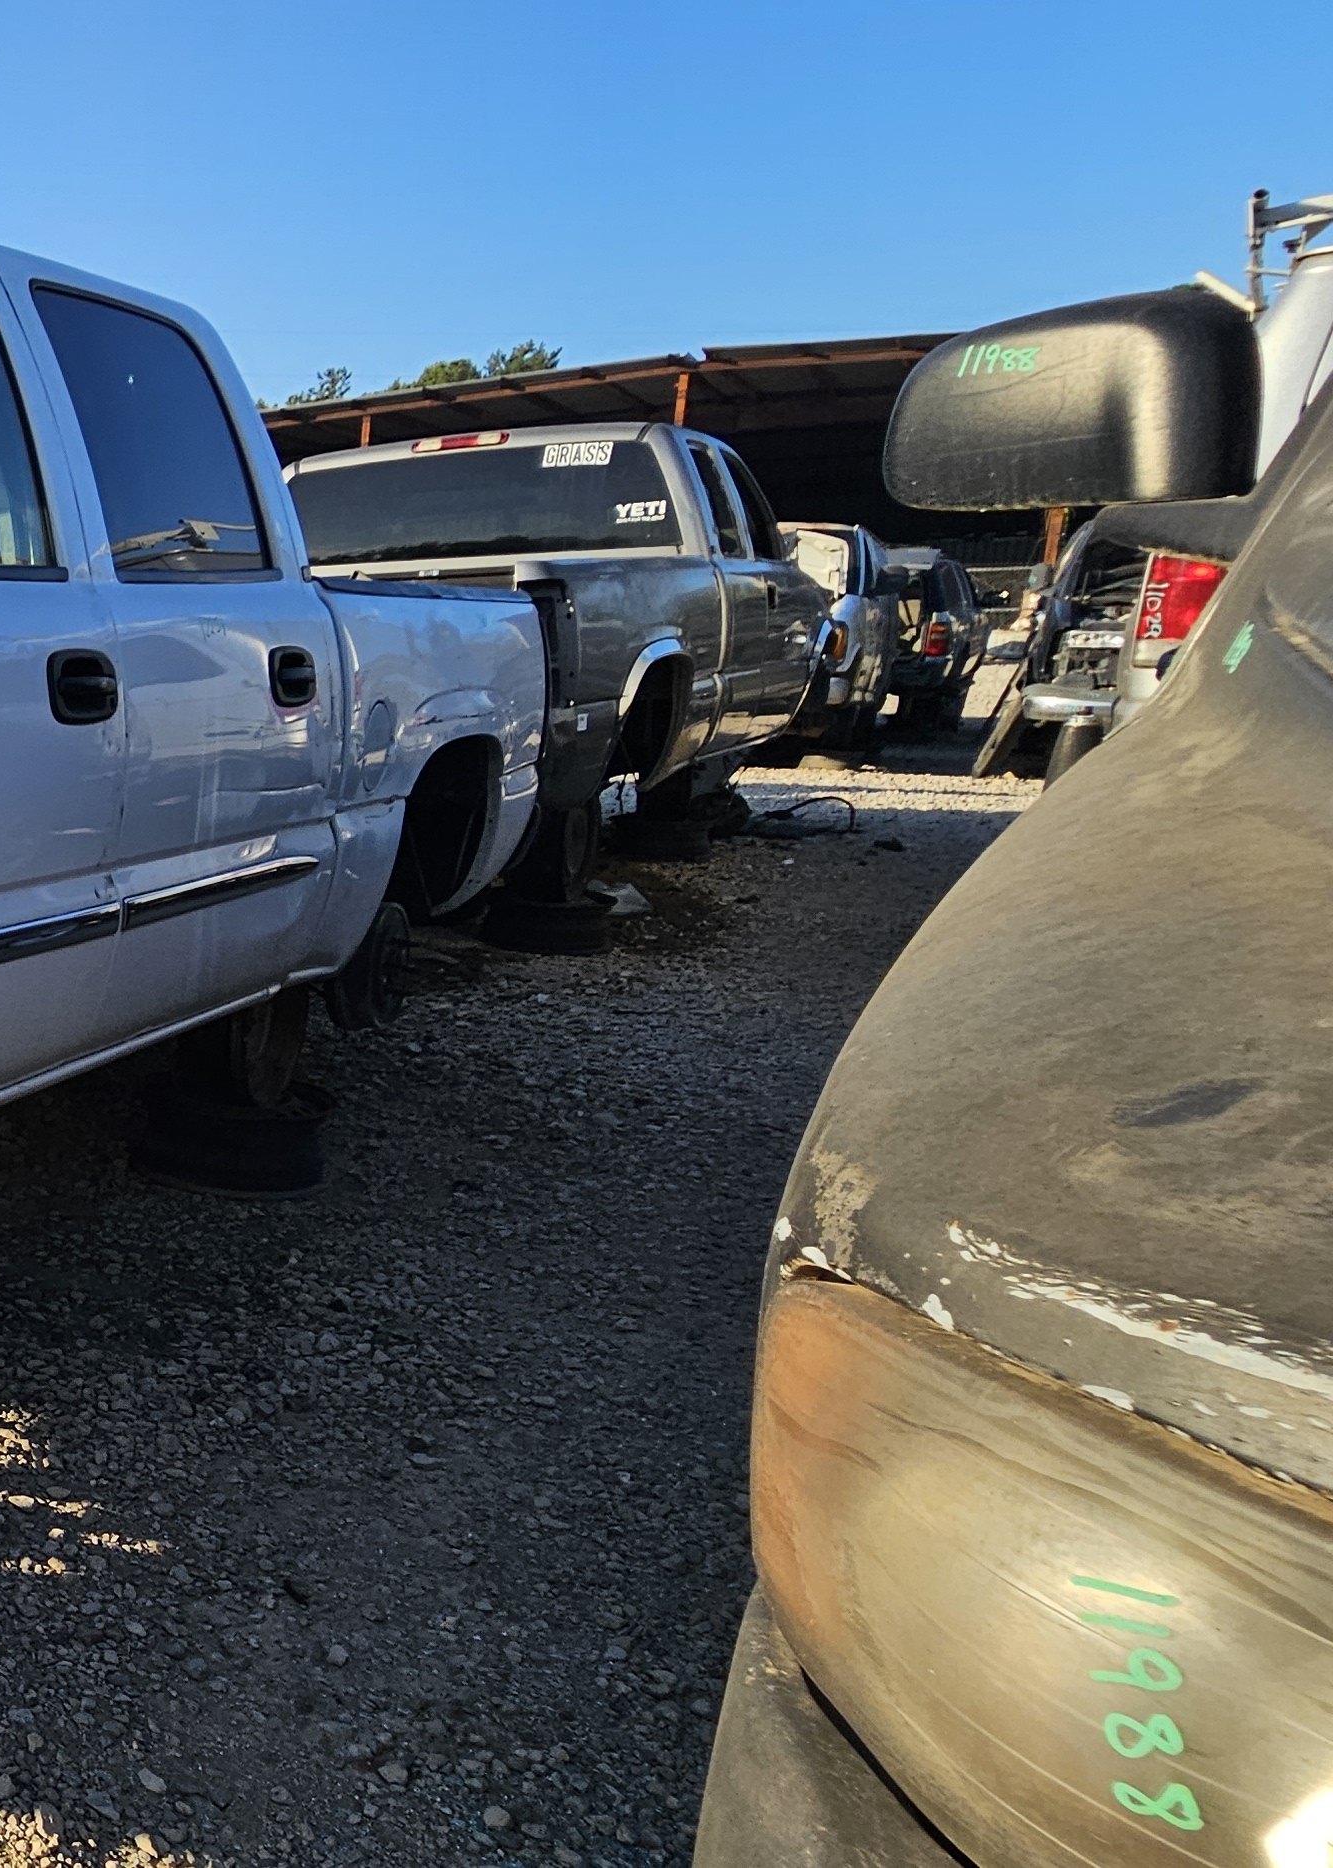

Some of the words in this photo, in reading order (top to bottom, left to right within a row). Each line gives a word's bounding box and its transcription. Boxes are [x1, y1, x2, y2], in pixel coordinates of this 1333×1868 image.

[957, 344, 1041, 378] 11988
[545, 442, 611, 465] GRASS
[616, 500, 666, 518] YETI
[1070, 1575, 1204, 1830] 11988
